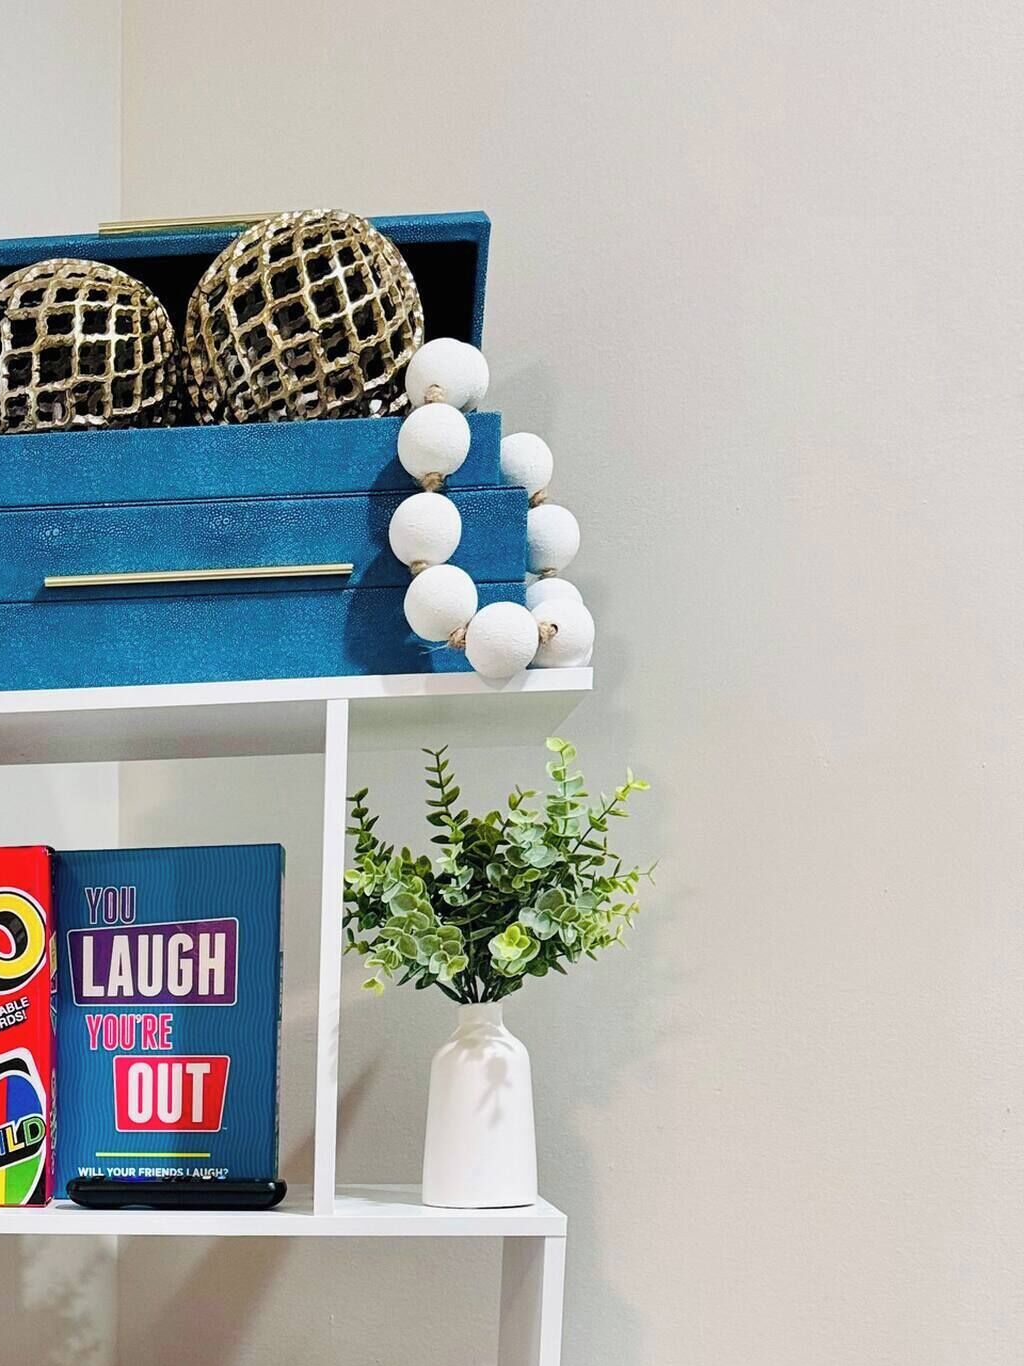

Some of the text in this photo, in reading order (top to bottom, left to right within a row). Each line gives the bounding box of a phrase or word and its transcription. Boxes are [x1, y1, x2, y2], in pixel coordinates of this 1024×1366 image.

[84, 886, 136, 925] YOU
[81, 932, 226, 998] LAUGH
[84, 1012, 173, 1051] YOU'RE
[127, 1061, 213, 1126] OUT
[78, 1167, 229, 1179] WILL YOUR FRIENDS LAUGH?
